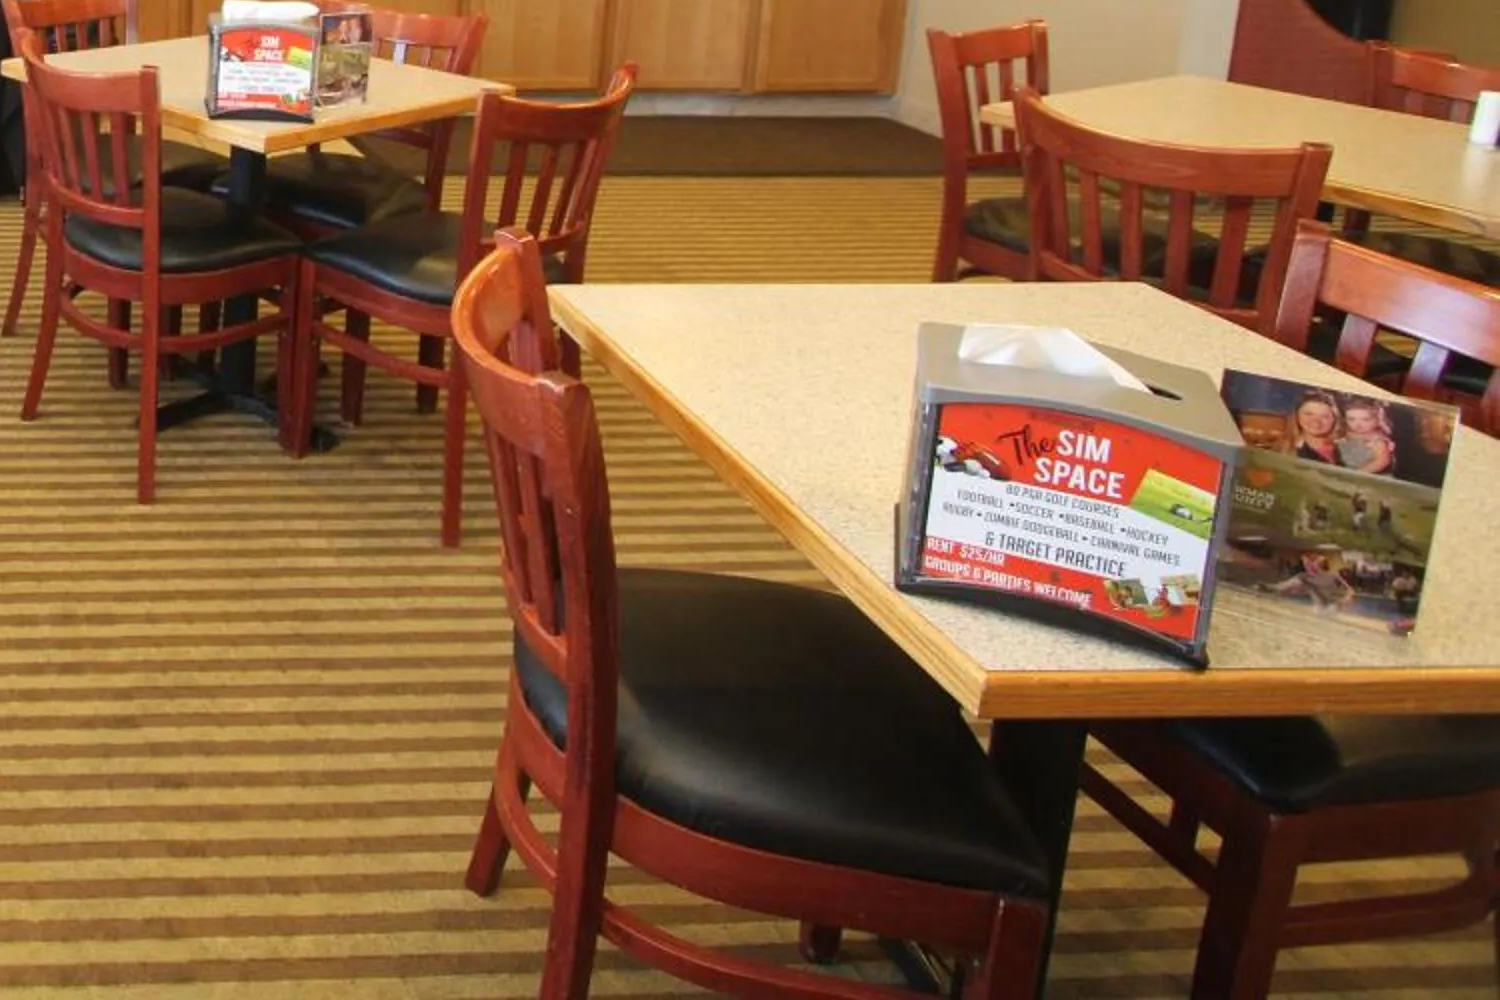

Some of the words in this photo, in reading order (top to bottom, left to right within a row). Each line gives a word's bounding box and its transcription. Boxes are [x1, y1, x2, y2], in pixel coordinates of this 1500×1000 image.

[997, 424, 1055, 466] The
[1057, 430, 1111, 464] SIM
[1034, 457, 1125, 498] SPACE
[957, 488, 1003, 508] FOOTBALL
[1016, 502, 1055, 519] SOCCER
[1065, 513, 1115, 535] BASEBALL
[1126, 525, 1169, 546] HOCKEY
[1071, 497, 1120, 518] COURSES
[927, 537, 953, 554] RENT
[984, 511, 1020, 528] ZOMBIE
[1021, 519, 1079, 542] DODGEBALL
[1090, 535, 1140, 557] CARNIVAL
[1143, 547, 1180, 567] GAMES
[999, 533, 1052, 560] TARGET
[1055, 547, 1127, 577] PRACTICE
[925, 555, 972, 577] GROUPS
[983, 568, 1032, 592] PARTIES
[1034, 581, 1093, 608] WELCOME
